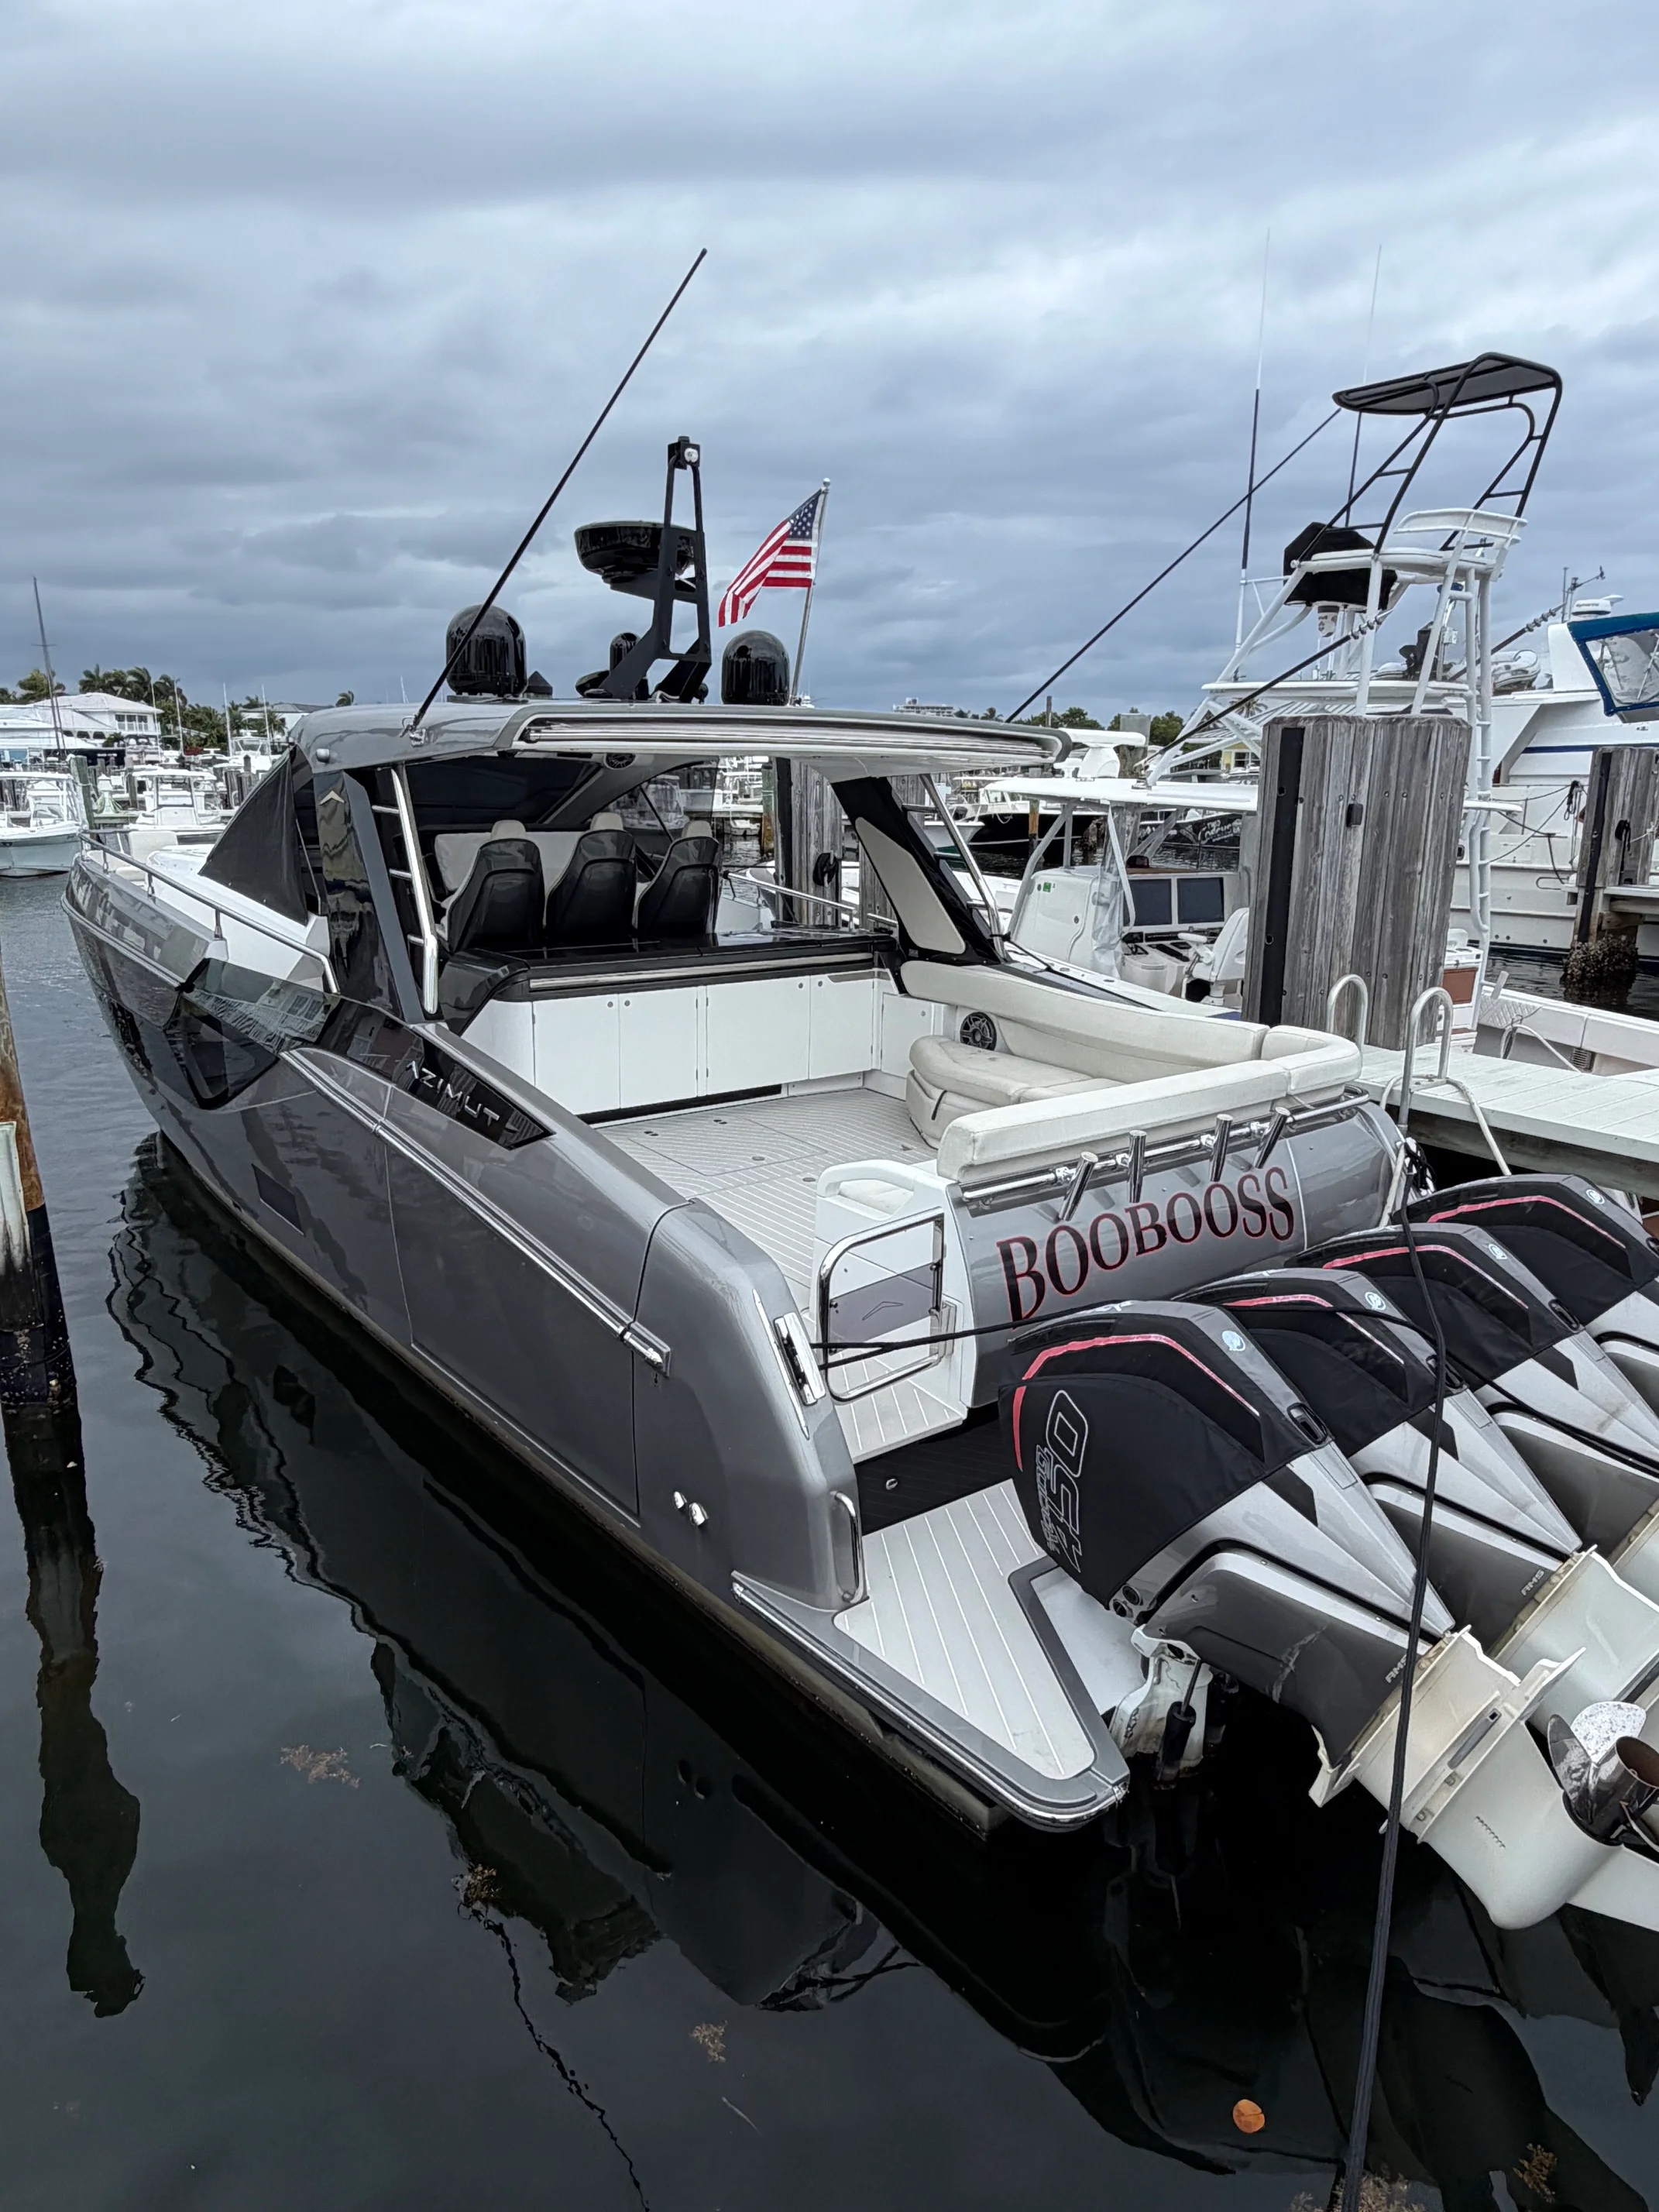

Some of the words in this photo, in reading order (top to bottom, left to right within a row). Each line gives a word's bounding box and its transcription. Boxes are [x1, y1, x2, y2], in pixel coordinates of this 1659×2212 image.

[405, 1060, 500, 1127] AZIMUT
[996, 1166, 1295, 1331] BOOBOOSS
[1046, 1389, 1088, 1573] 450
